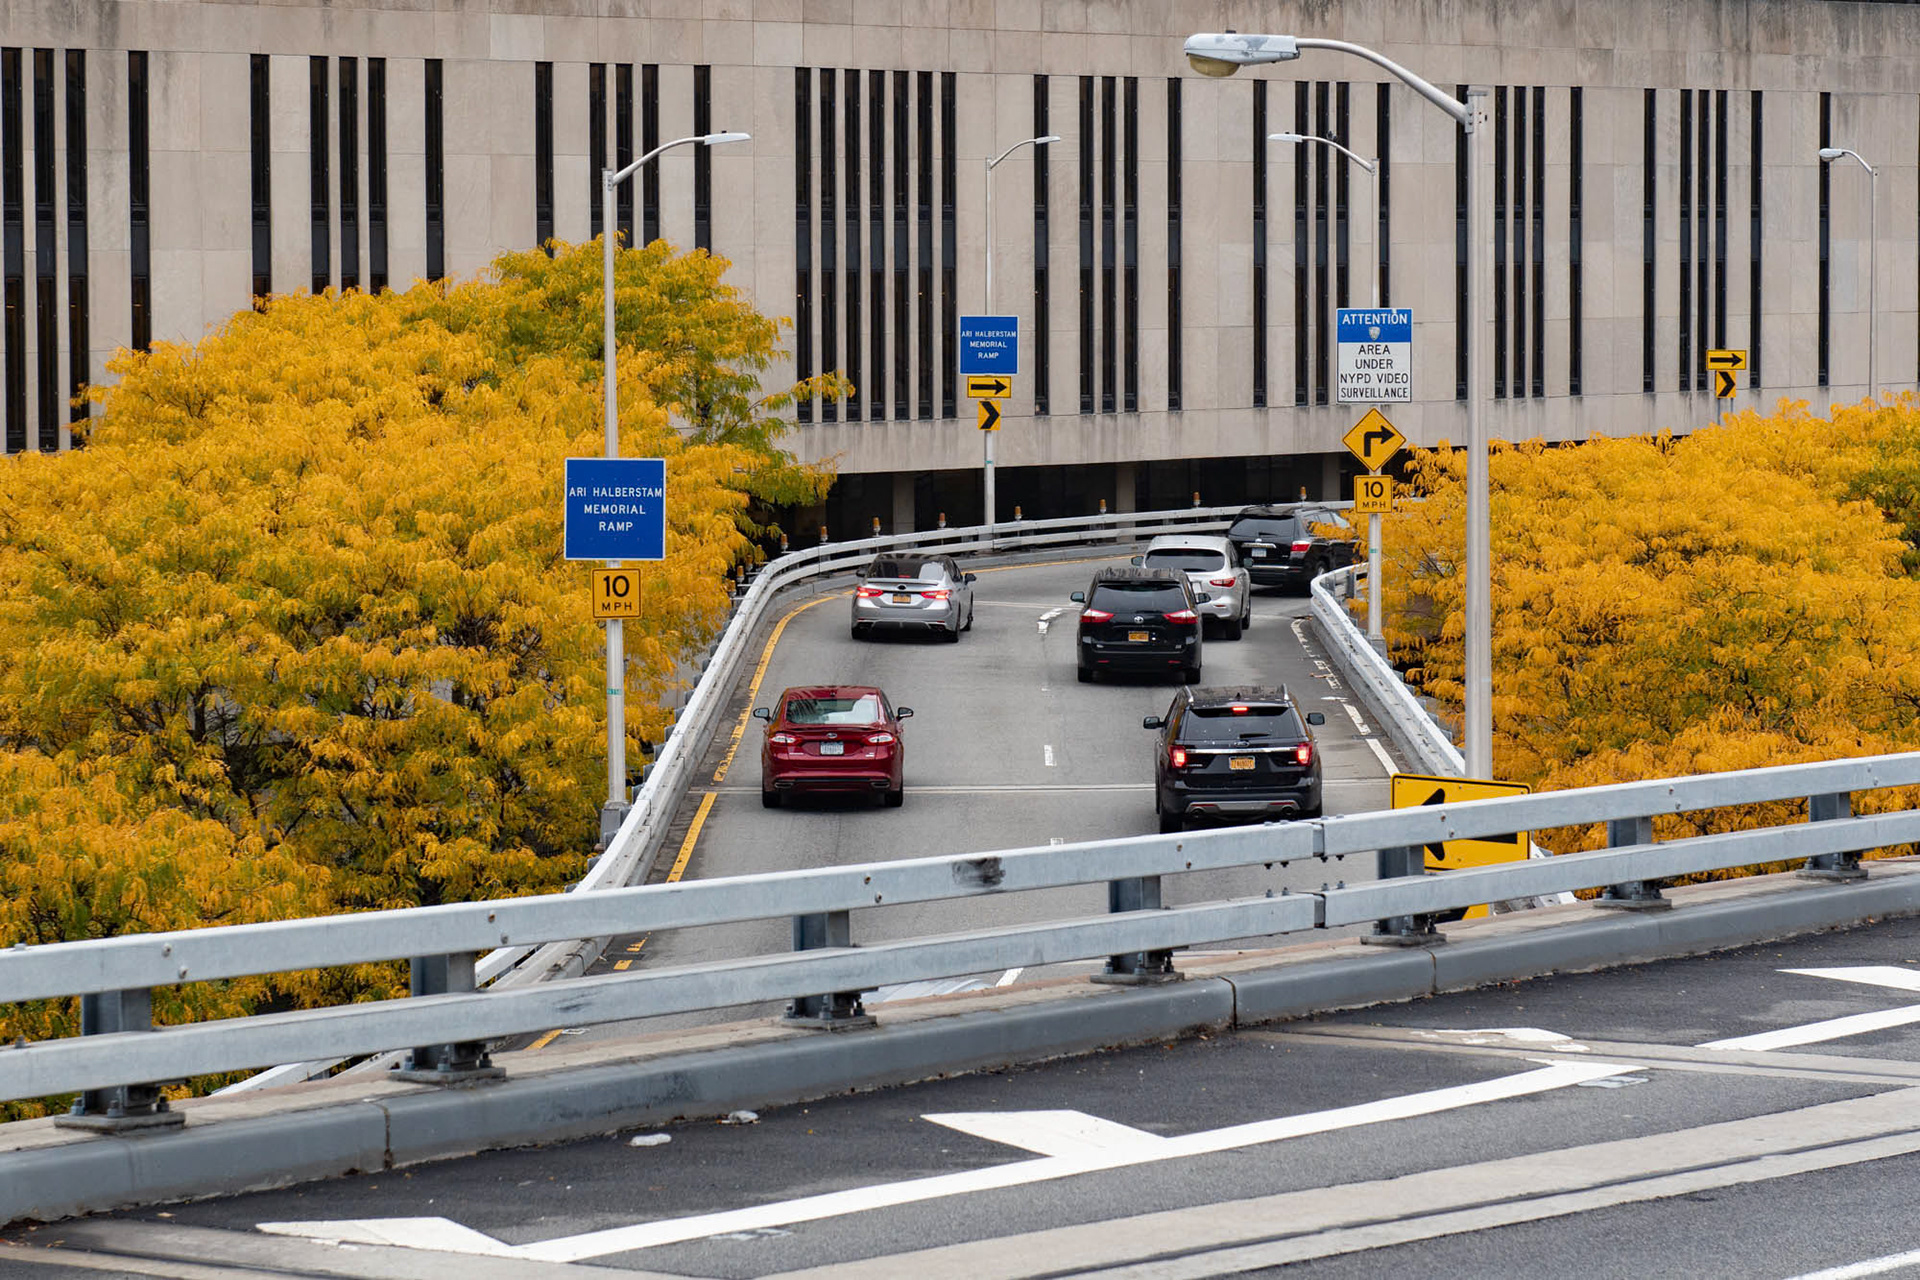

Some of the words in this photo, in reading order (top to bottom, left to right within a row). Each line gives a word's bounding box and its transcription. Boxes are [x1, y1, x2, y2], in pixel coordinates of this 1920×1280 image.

[1342, 314, 1408, 325] ATTENTION
[1358, 344, 1391, 355] AREA
[1355, 359, 1394, 370] UNDER
[1340, 373, 1372, 384] NYPD
[1376, 373, 1409, 384] VIDEO
[1340, 387, 1409, 399] SURVEILLANCE
[568, 487, 587, 497] ARI
[593, 487, 662, 497] HALBERSTAM
[1363, 481, 1384, 498] 10
[584, 504, 646, 514] MEMORIAL
[598, 521, 633, 531] RAMP
[603, 575, 630, 598] 10
[601, 602, 632, 612] MPH
